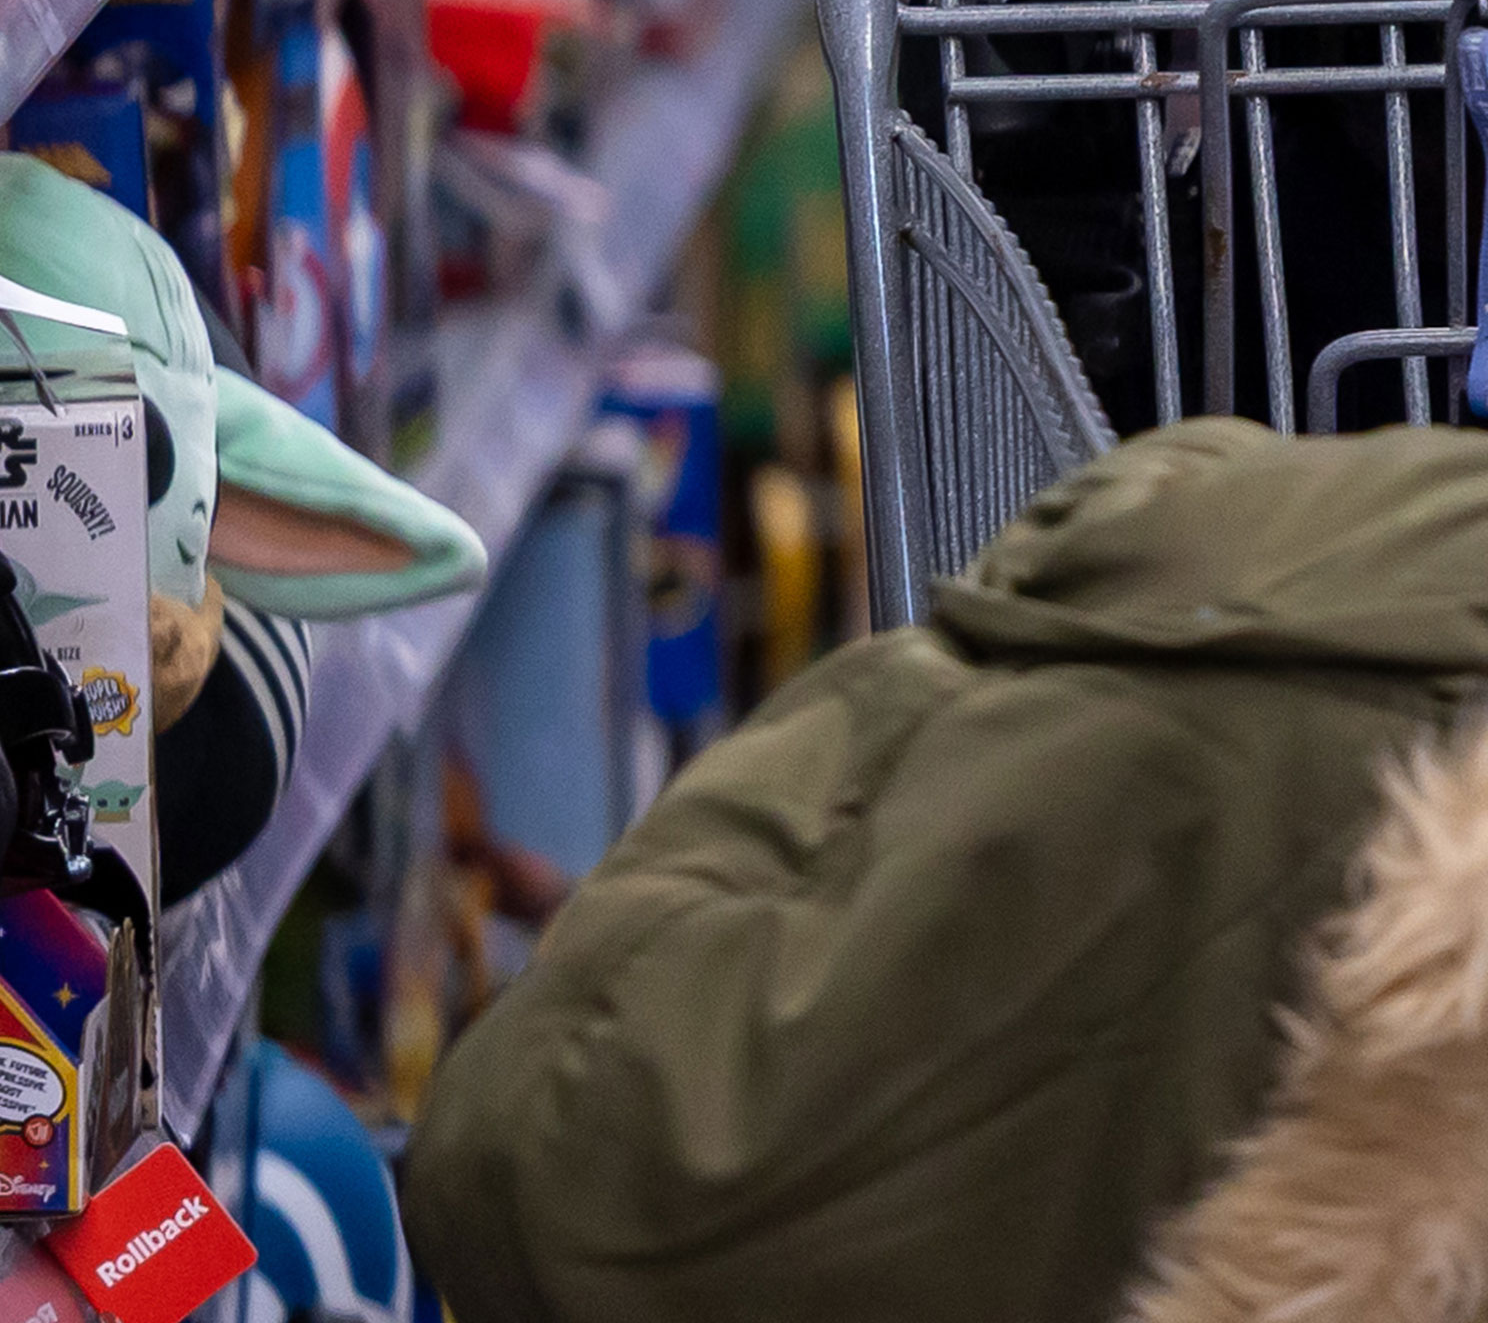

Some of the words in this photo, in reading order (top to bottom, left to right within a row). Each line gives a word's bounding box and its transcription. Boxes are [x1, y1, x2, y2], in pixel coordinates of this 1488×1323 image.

[122, 415, 134, 440] 3
[46, 464, 116, 541] SQUISHY!
[95, 1195, 210, 1288] Rollback
